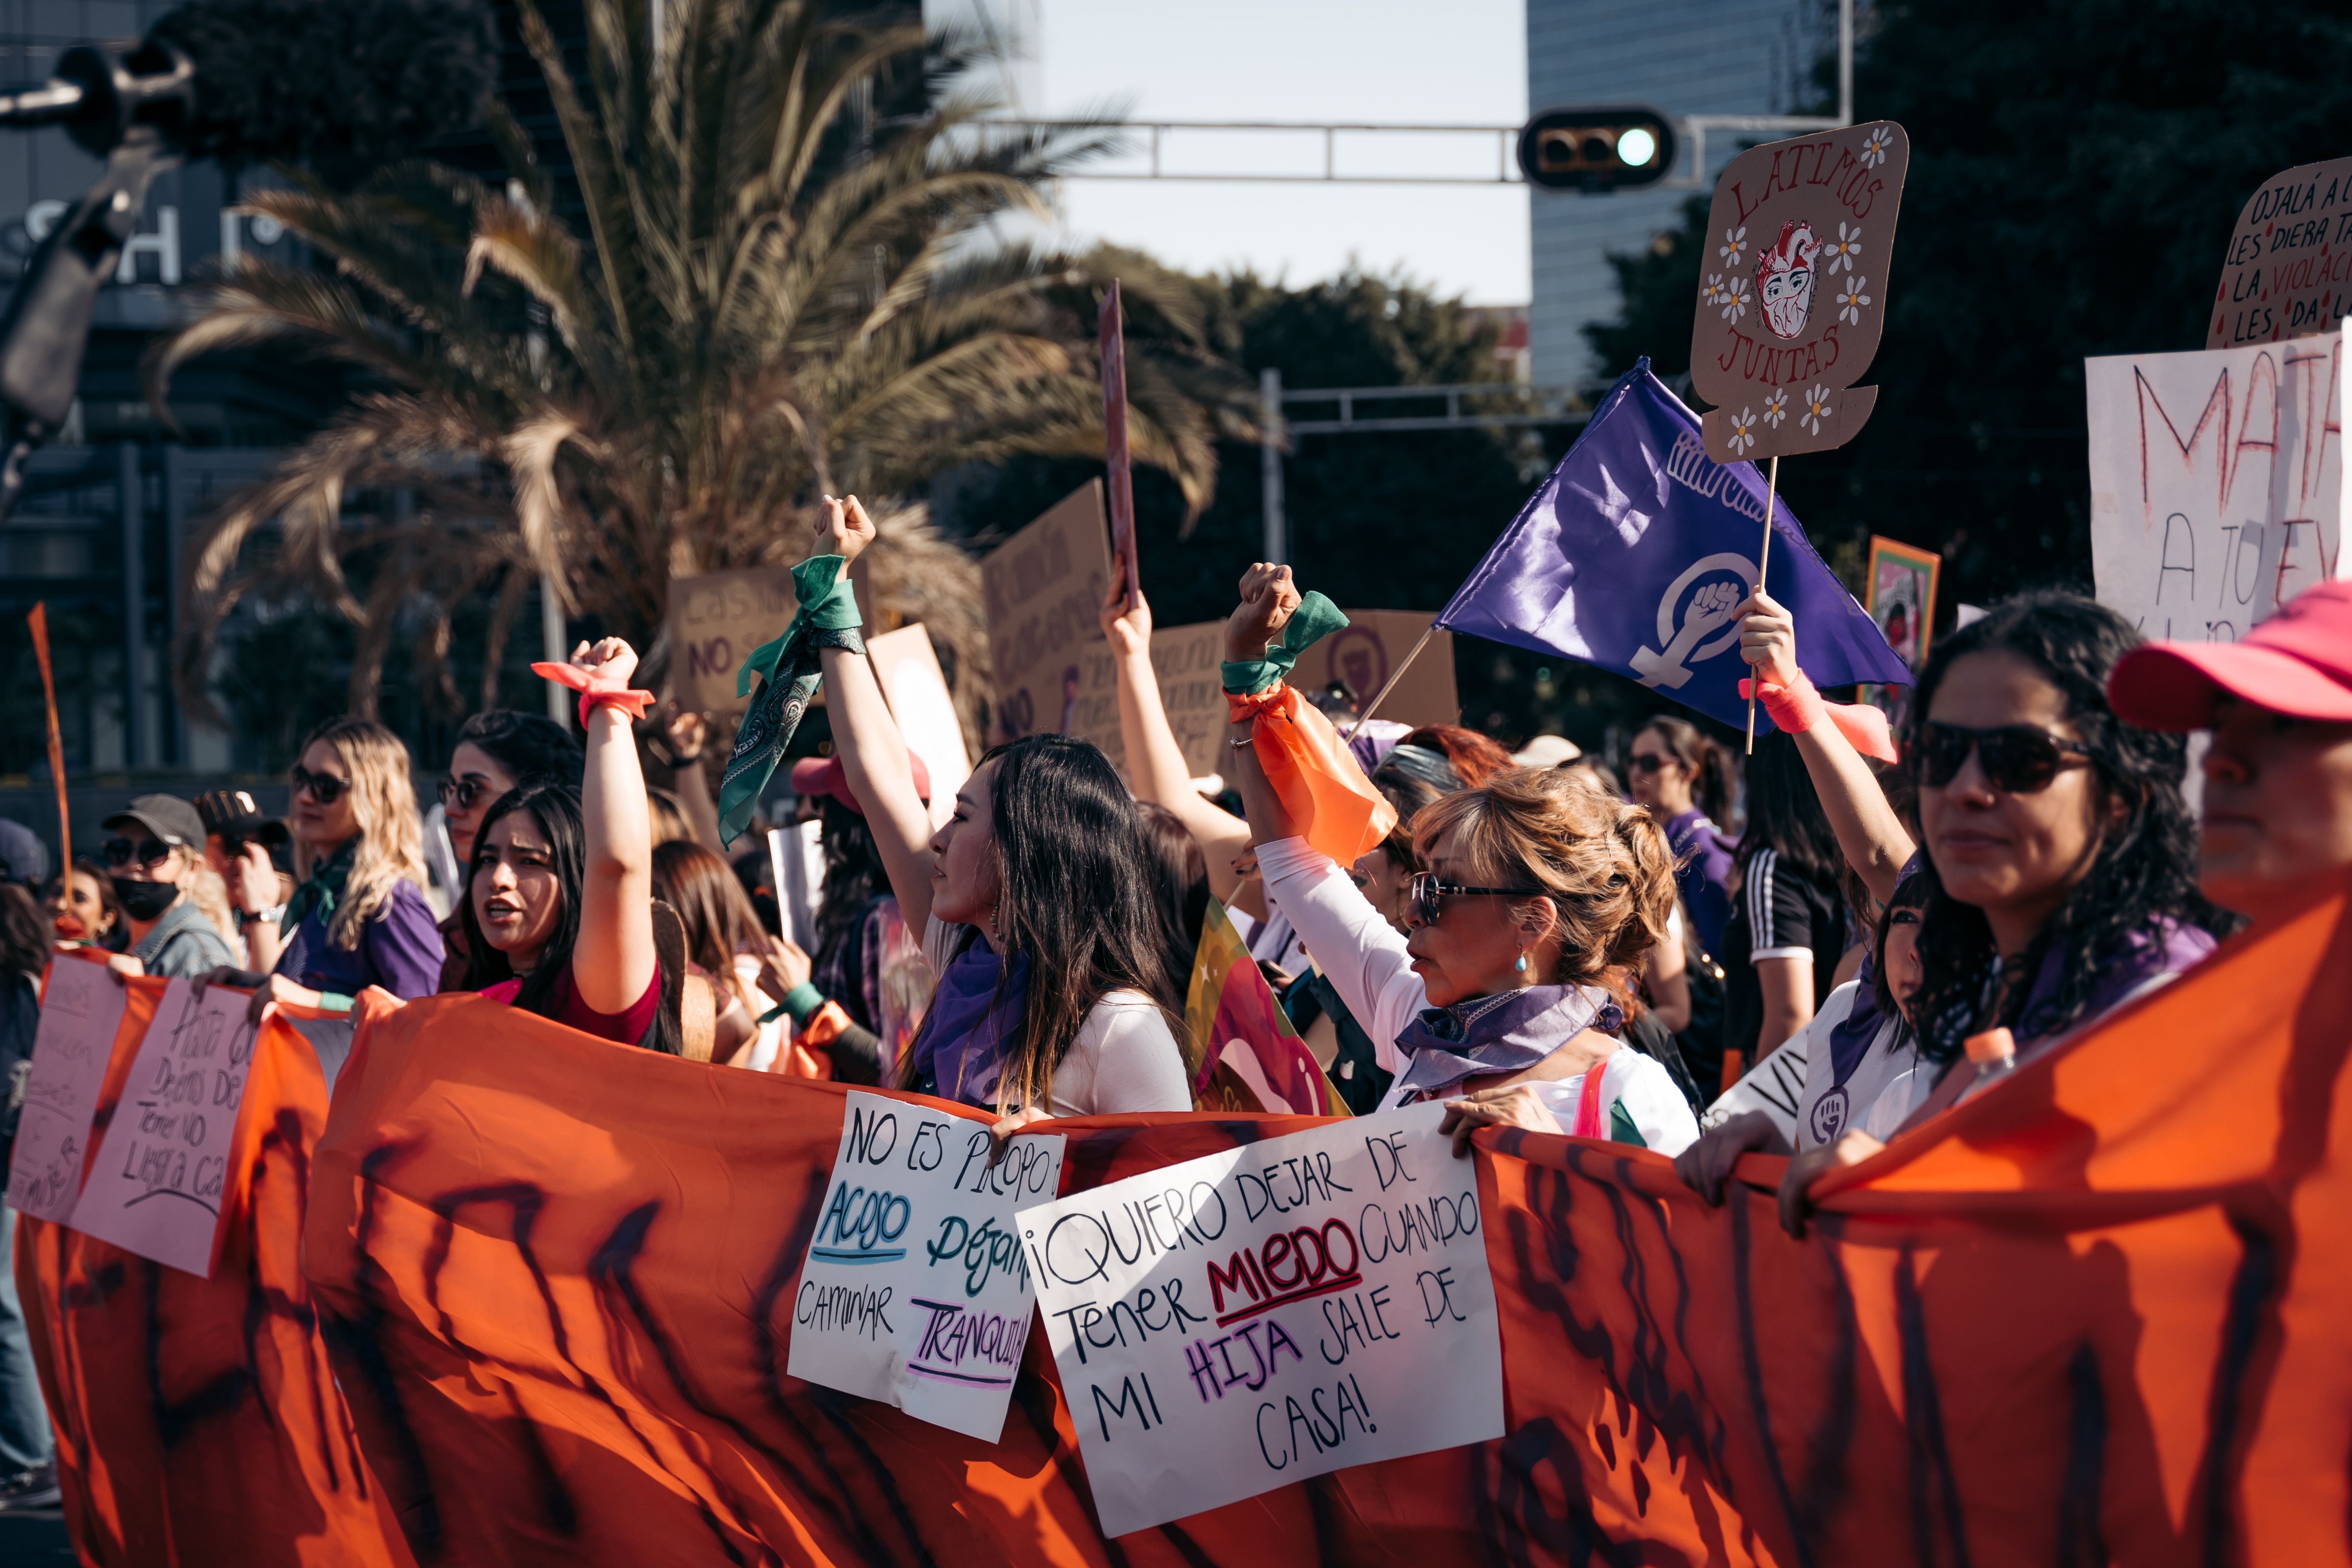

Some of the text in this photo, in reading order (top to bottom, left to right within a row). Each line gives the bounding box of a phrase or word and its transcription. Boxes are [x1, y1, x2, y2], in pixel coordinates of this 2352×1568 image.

[1730, 141, 1883, 227] LATIMOS
[2250, 171, 2322, 225] OJALÁ
[2321, 177, 2338, 210] A
[2227, 233, 2262, 265] LES
[2270, 217, 2330, 254] DIERA
[2233, 269, 2261, 302] LA
[2234, 308, 2272, 342] LES
[2291, 298, 2318, 327] DA
[1718, 324, 1840, 386] JUNTAS
[688, 634, 734, 679] NO
[846, 1107, 897, 1165] NO
[908, 1121, 950, 1171] ES
[953, 1130, 1050, 1203] PIROPO
[1025, 1131, 1416, 1289] ¡QUIERO DEJAR DE
[1359, 1191, 1479, 1263] CUANDO
[797, 1280, 894, 1341] CAMINAR
[1091, 1266, 1467, 1442] MI HIJA SALE DE
[1256, 1373, 1378, 1470] CASA!
